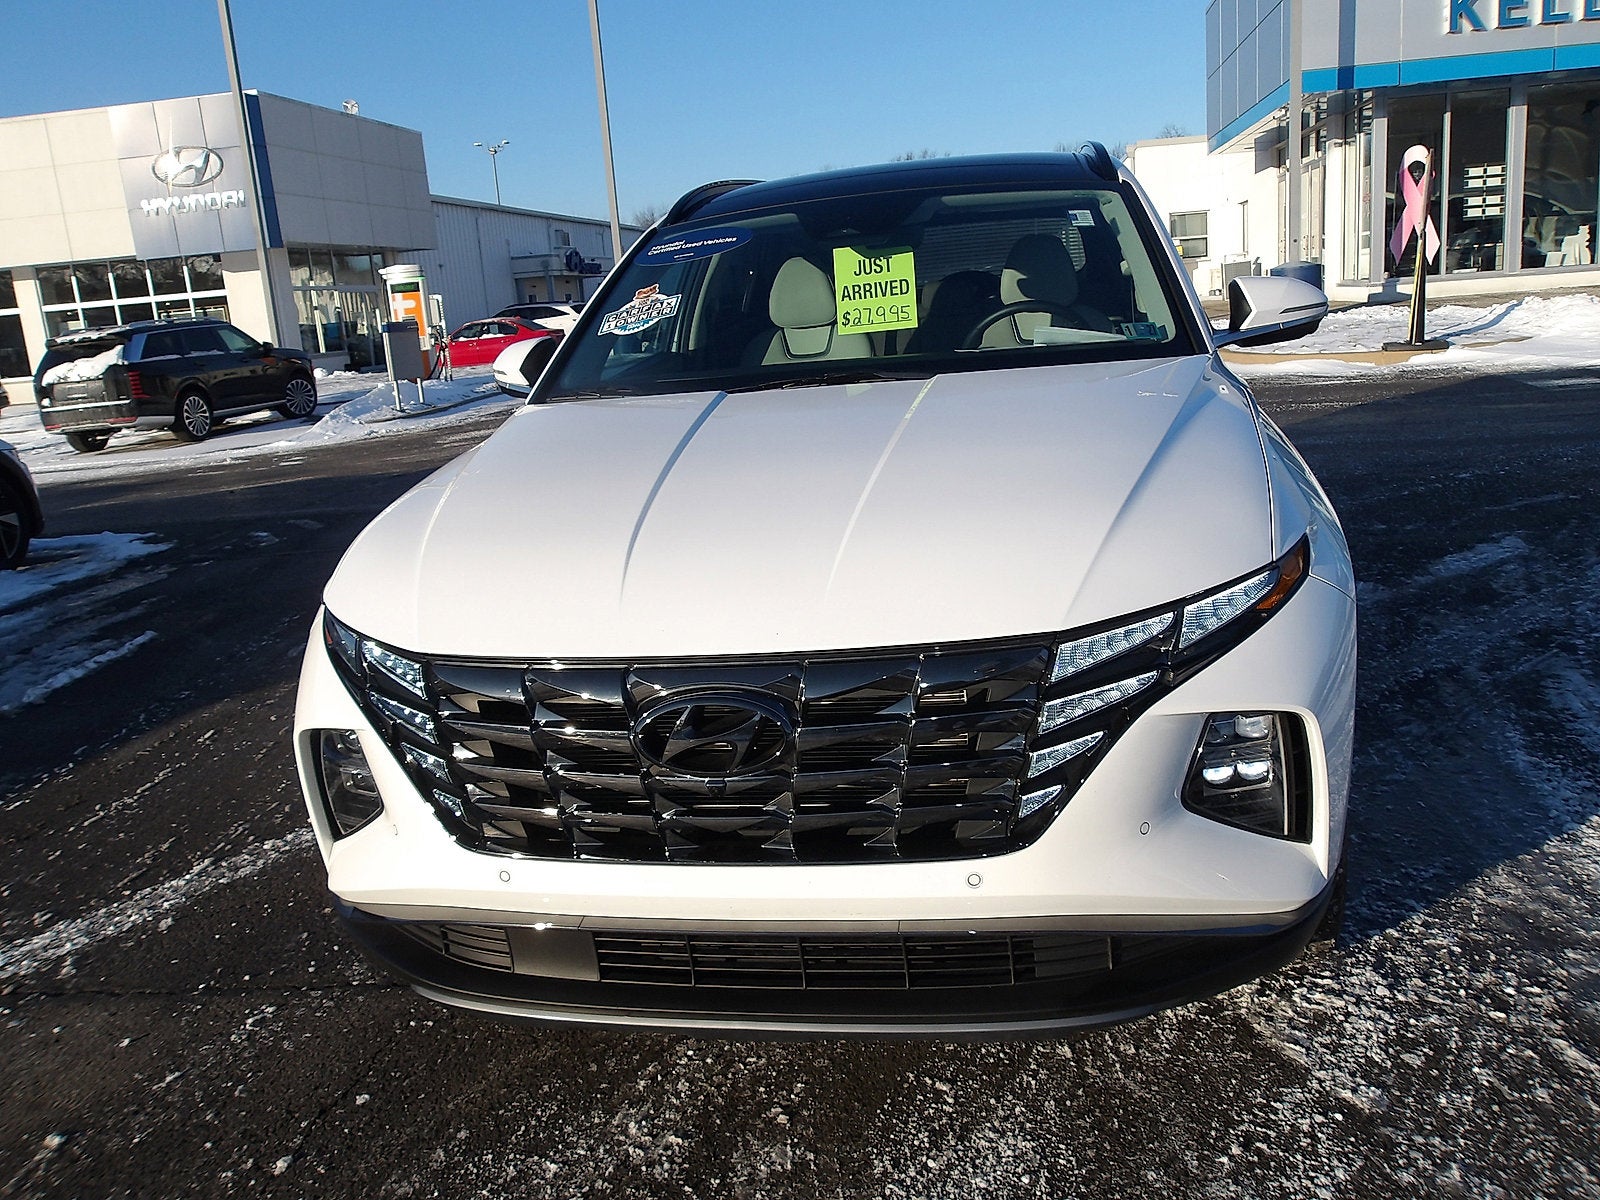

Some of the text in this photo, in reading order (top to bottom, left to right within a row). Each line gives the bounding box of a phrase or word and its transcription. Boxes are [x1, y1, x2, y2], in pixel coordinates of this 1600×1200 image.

[139, 189, 246, 216] HYUNDAI
[682, 240, 704, 249] Used
[704, 236, 738, 246] Vehicles
[853, 256, 893, 277] JUST
[841, 278, 911, 302] ARRIVED
[608, 299, 674, 322] CARFAX
[616, 307, 673, 327] OWNER
